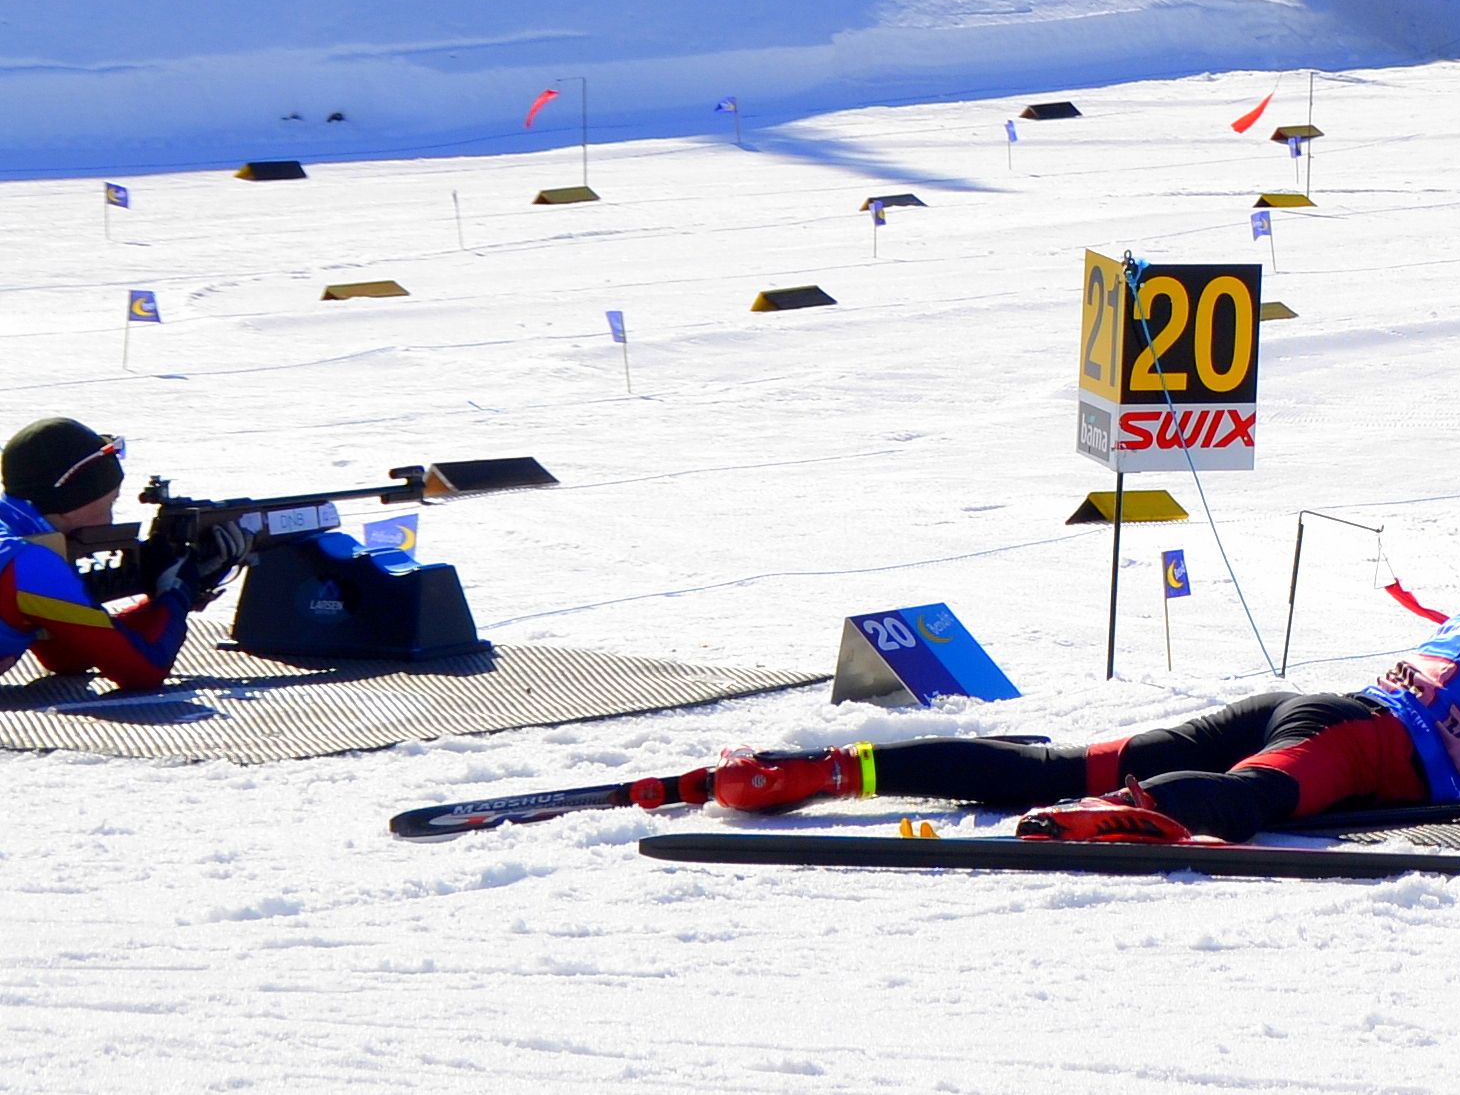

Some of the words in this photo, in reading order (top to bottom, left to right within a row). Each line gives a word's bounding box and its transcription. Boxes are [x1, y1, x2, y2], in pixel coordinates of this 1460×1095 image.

[1084, 265, 1120, 388] 21
[1130, 275, 1253, 393] 20
[1113, 410, 1256, 450] SWIX
[863, 616, 917, 651] 20
